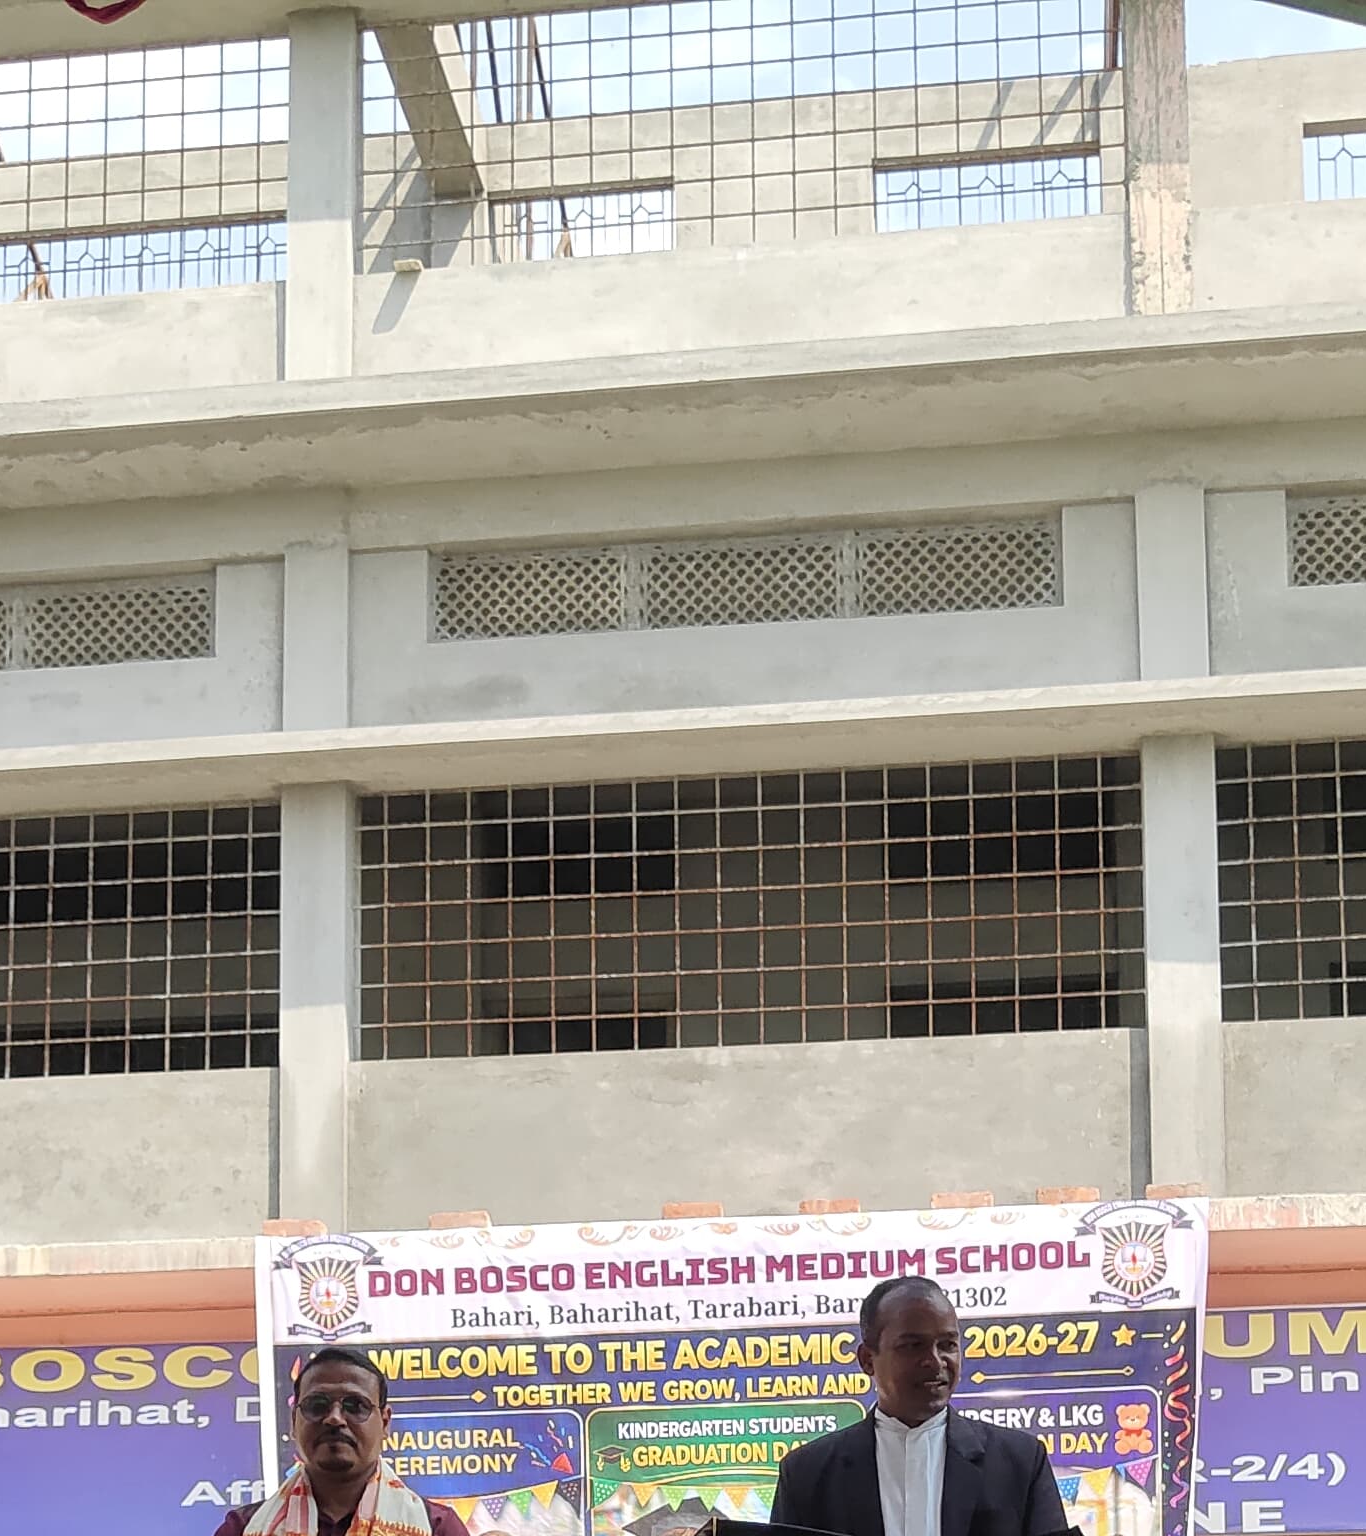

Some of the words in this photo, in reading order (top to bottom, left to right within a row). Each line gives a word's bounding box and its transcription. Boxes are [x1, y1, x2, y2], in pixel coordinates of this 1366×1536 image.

[368, 1268, 445, 1298] DON
[454, 1263, 574, 1294] BOSCO
[584, 1255, 755, 1290] ENGLISH
[766, 1248, 926, 1283] MEDIUM
[936, 1241, 1090, 1275] SCHOOL
[451, 1305, 540, 1330] Bahari,
[548, 1301, 680, 1326] Baharihat,
[687, 1296, 806, 1321] Tarabari,
[369, 1346, 538, 1381] WELCOME
[544, 1342, 593, 1375] TO
[603, 1340, 664, 1371] THE
[672, 1332, 856, 1368] ACADEMIC
[964, 1321, 1100, 1359] 2026-27
[493, 1383, 611, 1407] TOGETHER
[618, 1381, 655, 1403] WE
[663, 1377, 741, 1402] GROW,
[747, 1374, 817, 1399] LEARN
[821, 1371, 871, 1396] AND
[1250, 1364, 1360, 1395] Pin
[618, 1418, 745, 1440] KINDERGARTEN
[749, 1415, 838, 1434] STUDENTS
[1038, 1407, 1055, 1428] &
[1059, 1404, 1104, 1428] LKG
[382, 1428, 520, 1452] NAUGURAL
[633, 1441, 768, 1467] GRADUATION
[1060, 1431, 1108, 1454] DAY
